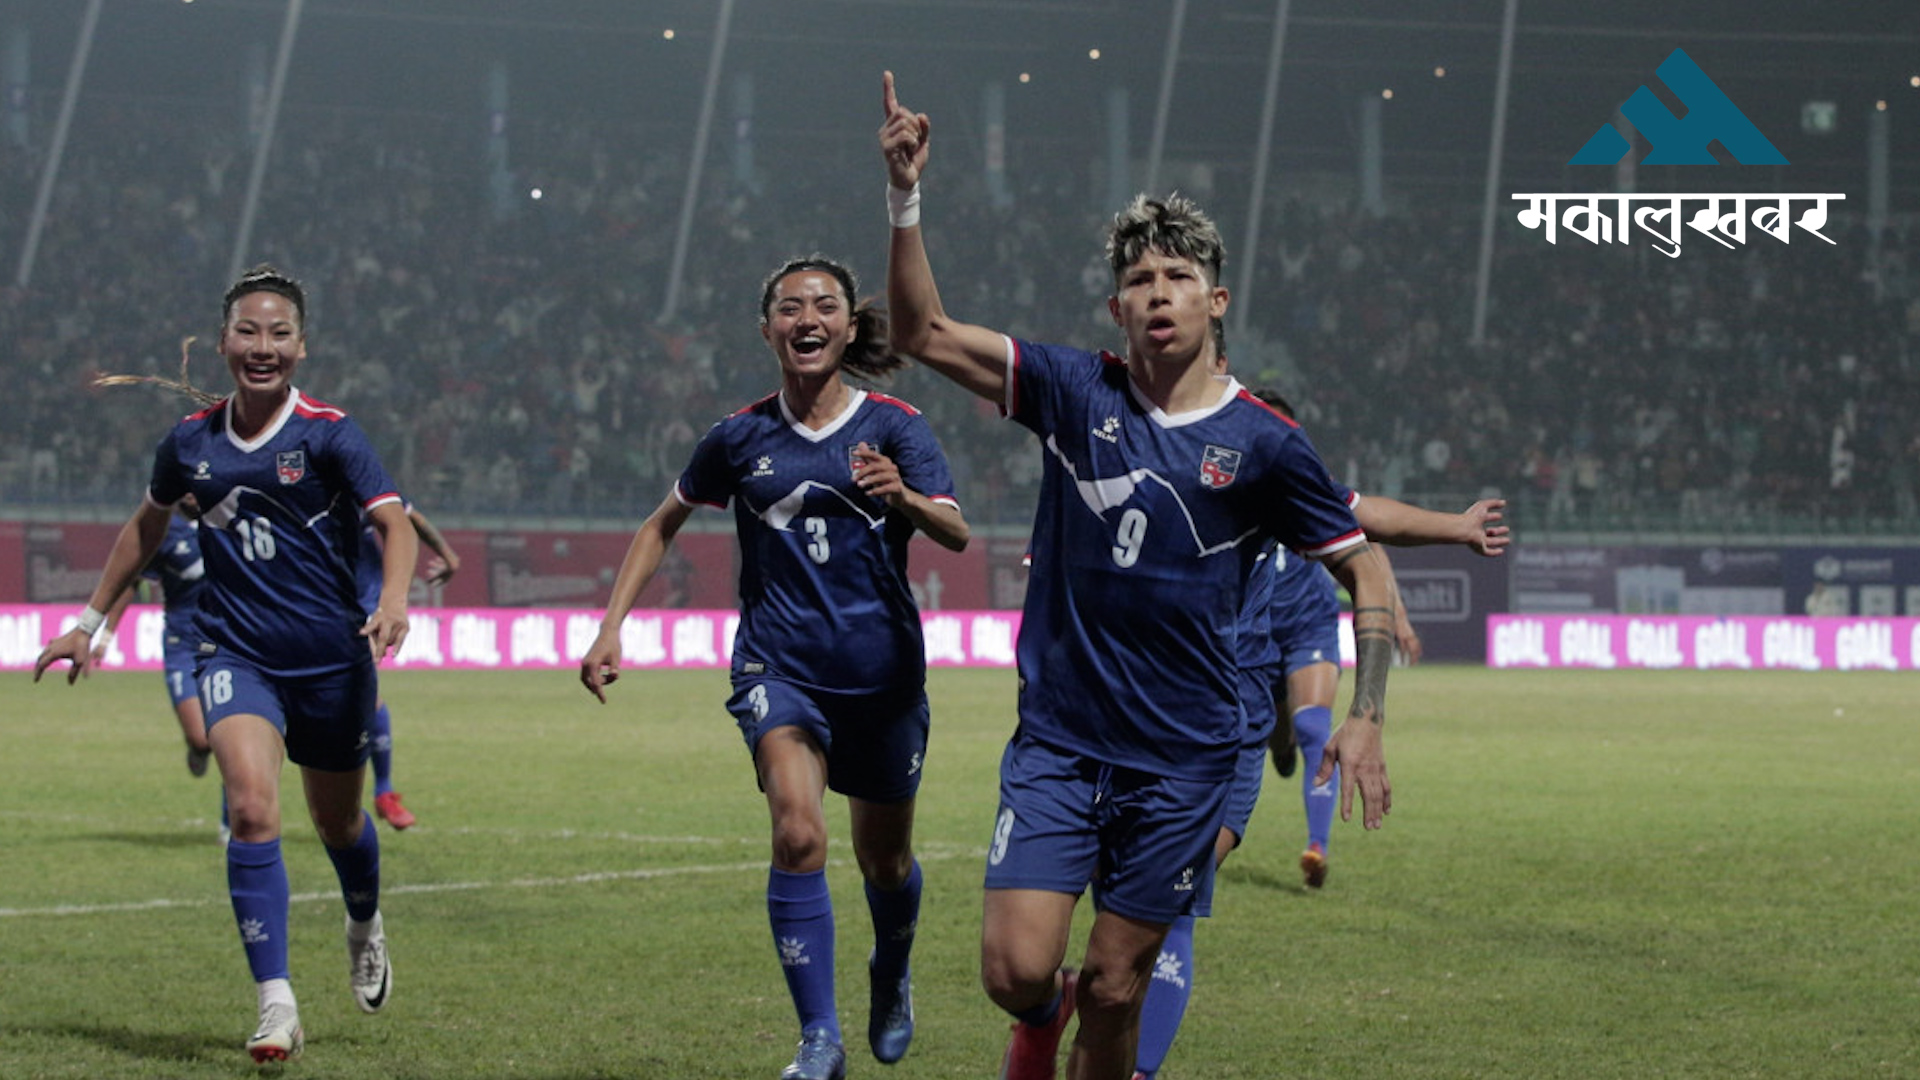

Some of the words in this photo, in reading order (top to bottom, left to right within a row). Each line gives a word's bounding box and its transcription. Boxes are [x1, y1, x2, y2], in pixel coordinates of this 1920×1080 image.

[235, 516, 276, 561] 18
[804, 516, 831, 564] 3
[1112, 508, 1148, 568] 9
[450, 614, 501, 666] GOAL
[511, 614, 560, 666] GOAL
[673, 615, 718, 665] GOAL
[971, 615, 1016, 665] GOAL
[1493, 620, 1550, 668] GOAL
[1560, 619, 1617, 669] GOAL
[1627, 620, 1685, 669] GOAL
[1694, 620, 1752, 670] GOAL
[1762, 620, 1821, 671] GOAL
[1835, 621, 1898, 671] GOAL
[201, 669, 233, 712] 18
[748, 684, 770, 722] 3
[990, 807, 1015, 866] 9
